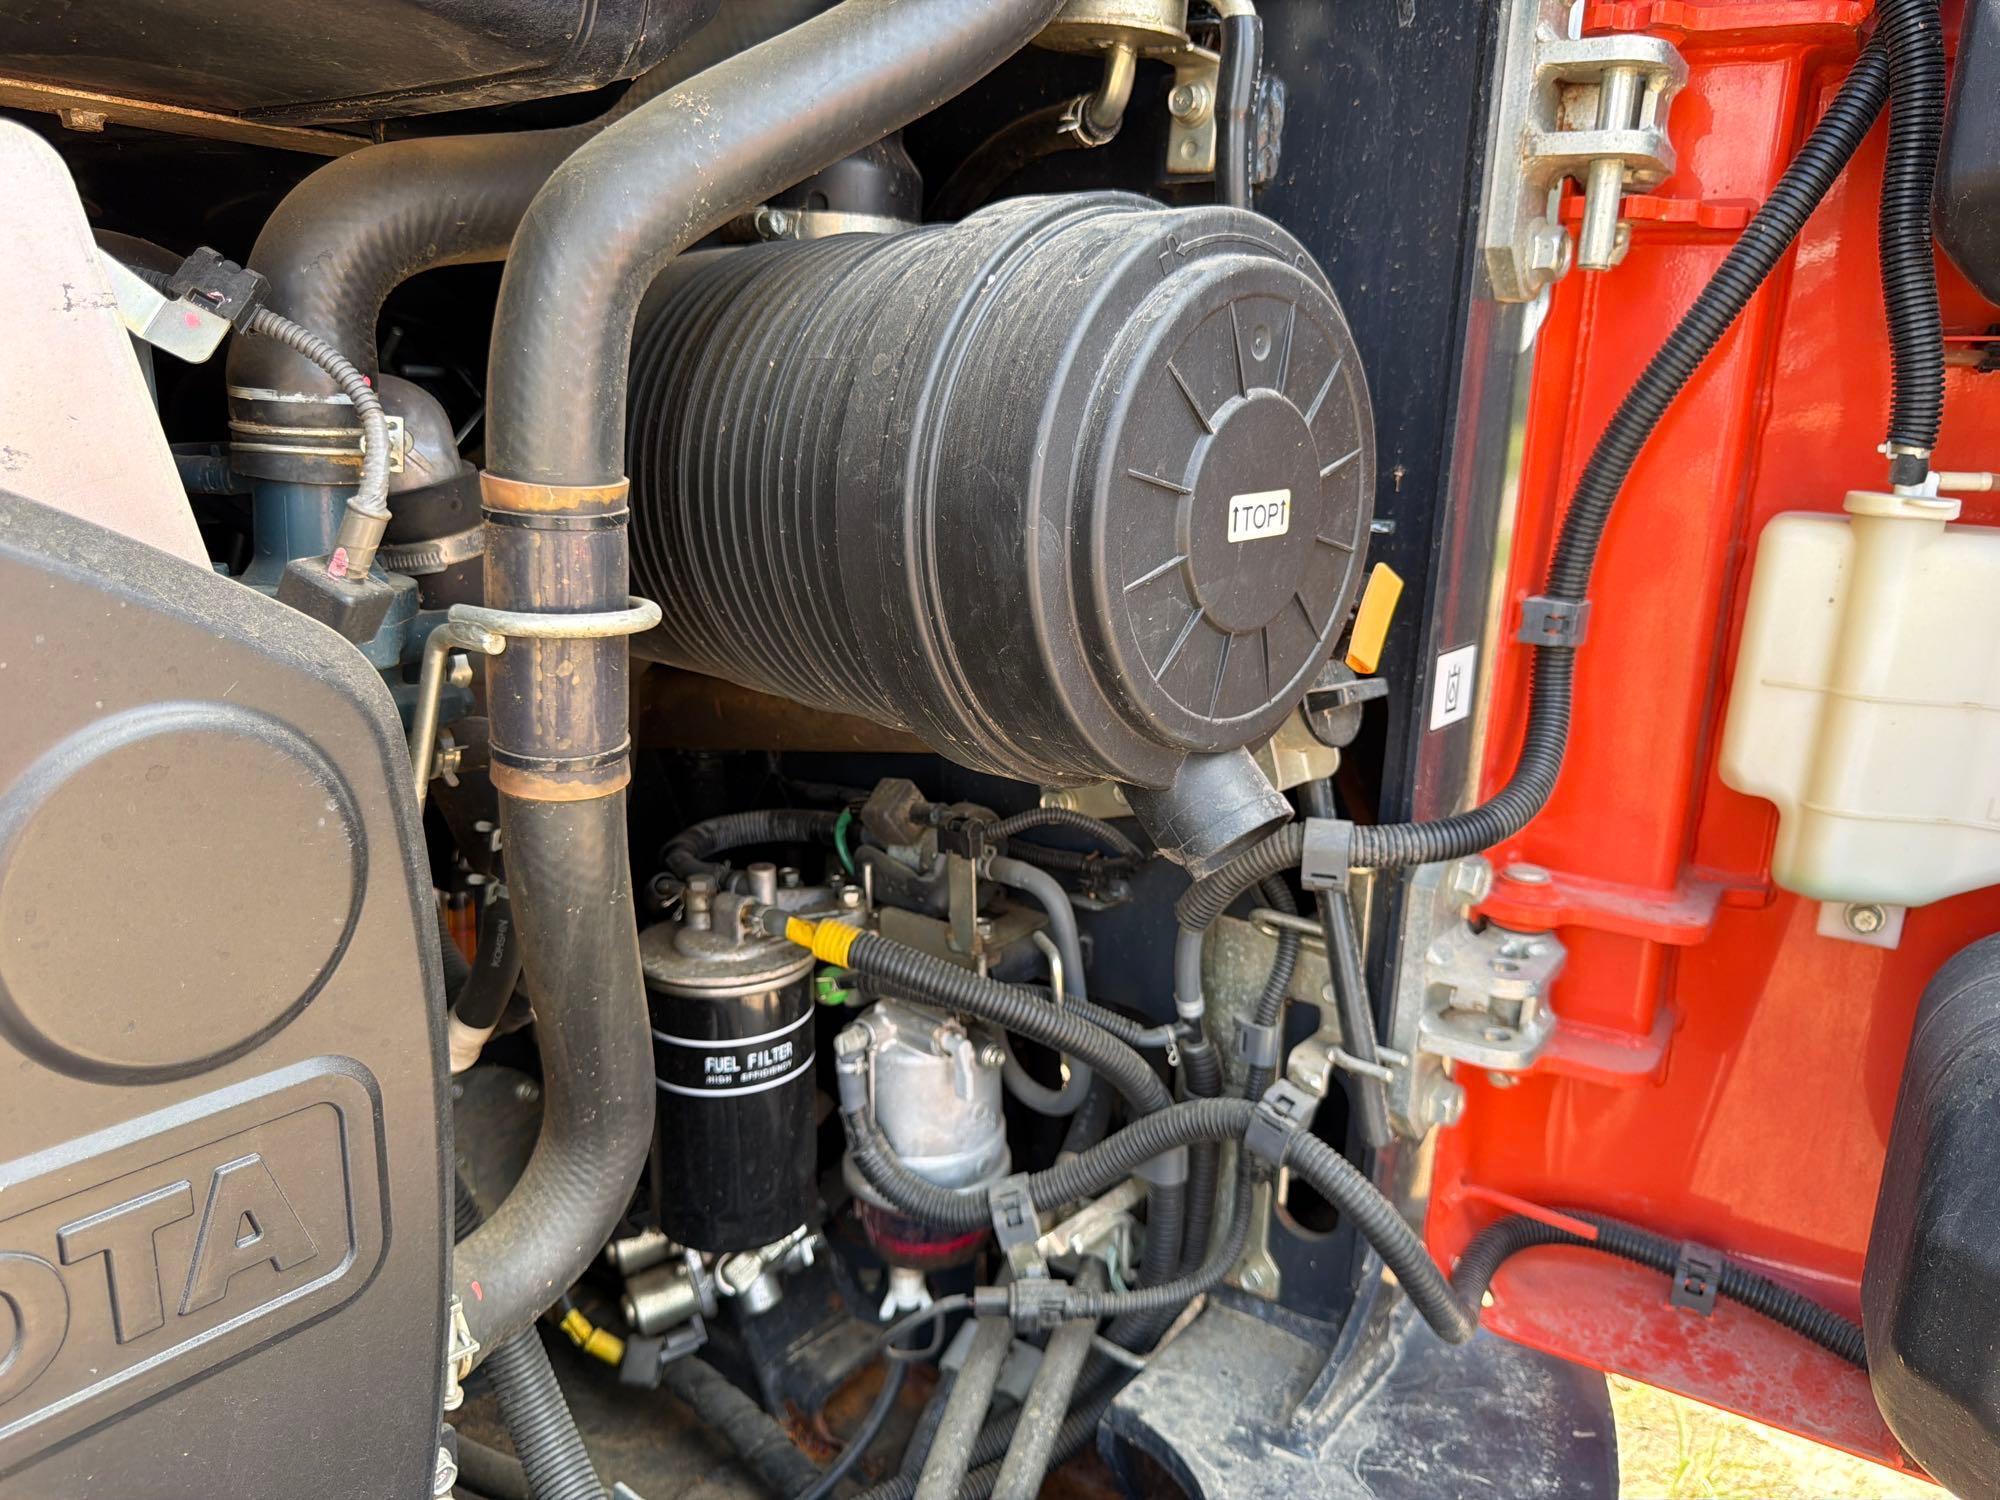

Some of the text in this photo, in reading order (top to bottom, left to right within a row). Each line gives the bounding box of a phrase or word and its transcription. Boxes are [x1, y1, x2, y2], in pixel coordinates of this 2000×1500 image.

[1242, 503, 1279, 531] TOP
[704, 1041, 793, 1074] FUEL FILTER
[705, 1074, 733, 1085] HIGH
